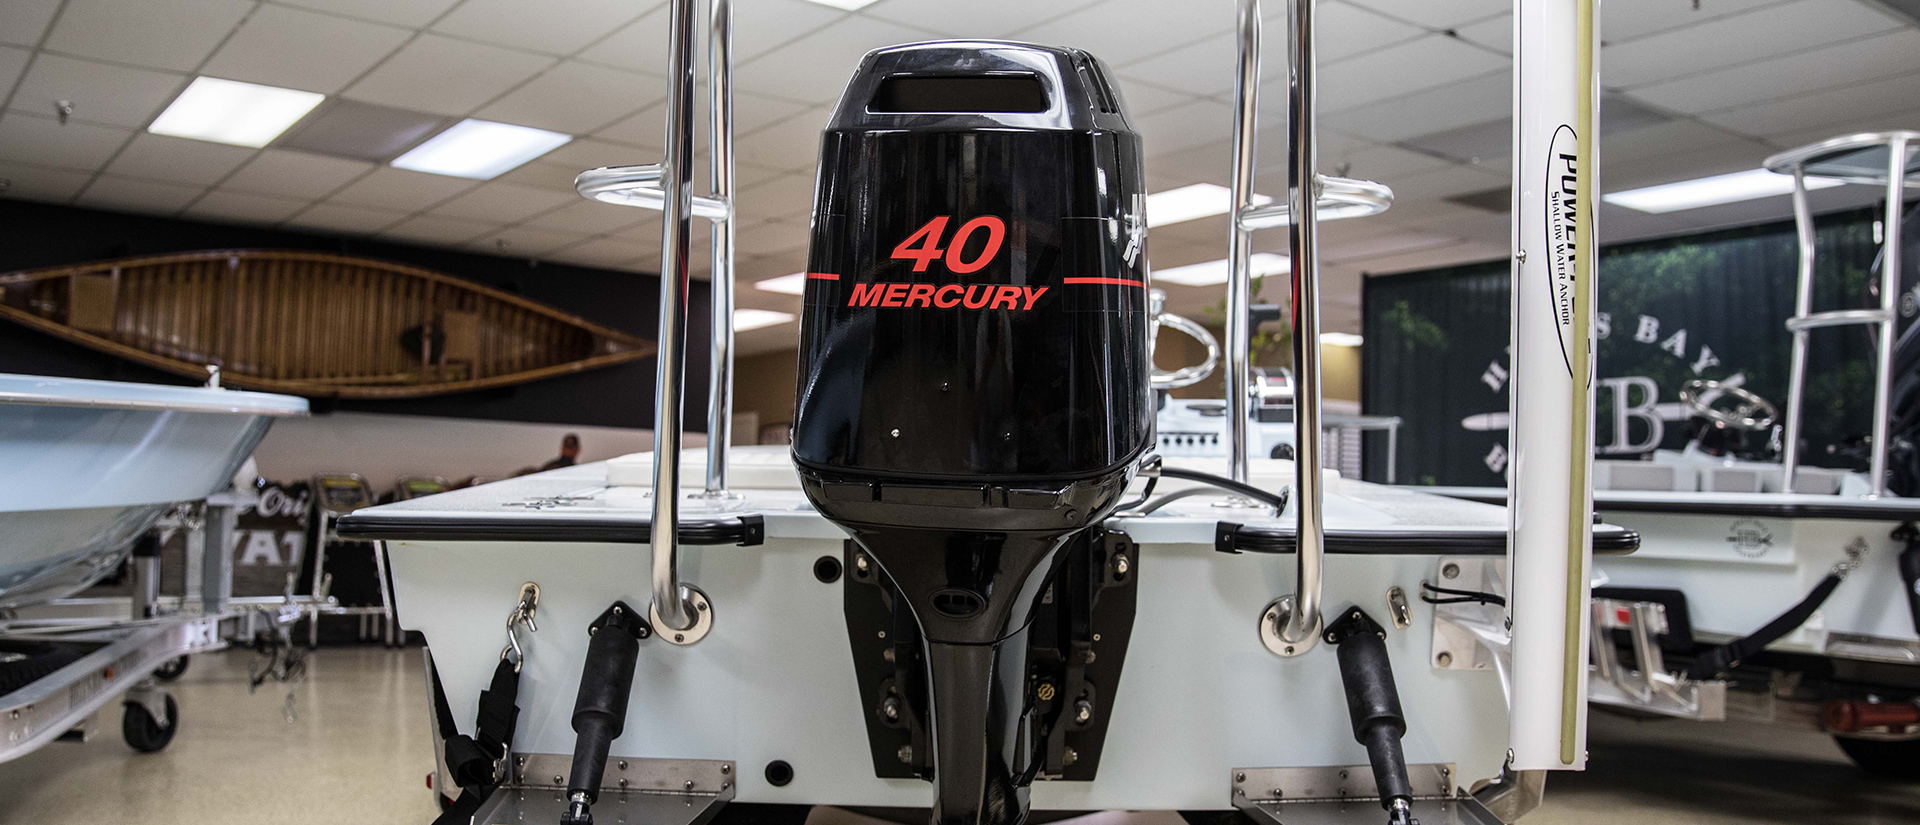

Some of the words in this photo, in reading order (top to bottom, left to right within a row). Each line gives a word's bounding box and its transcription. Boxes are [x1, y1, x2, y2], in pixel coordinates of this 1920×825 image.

[1550, 190, 1563, 241] SHALLOW
[890, 215, 1006, 274] 40
[1555, 242, 1566, 282] WATER
[847, 283, 1049, 311] MERCURY
[1559, 283, 1571, 326] ANCHOR
[1634, 313, 1721, 376] BAY
